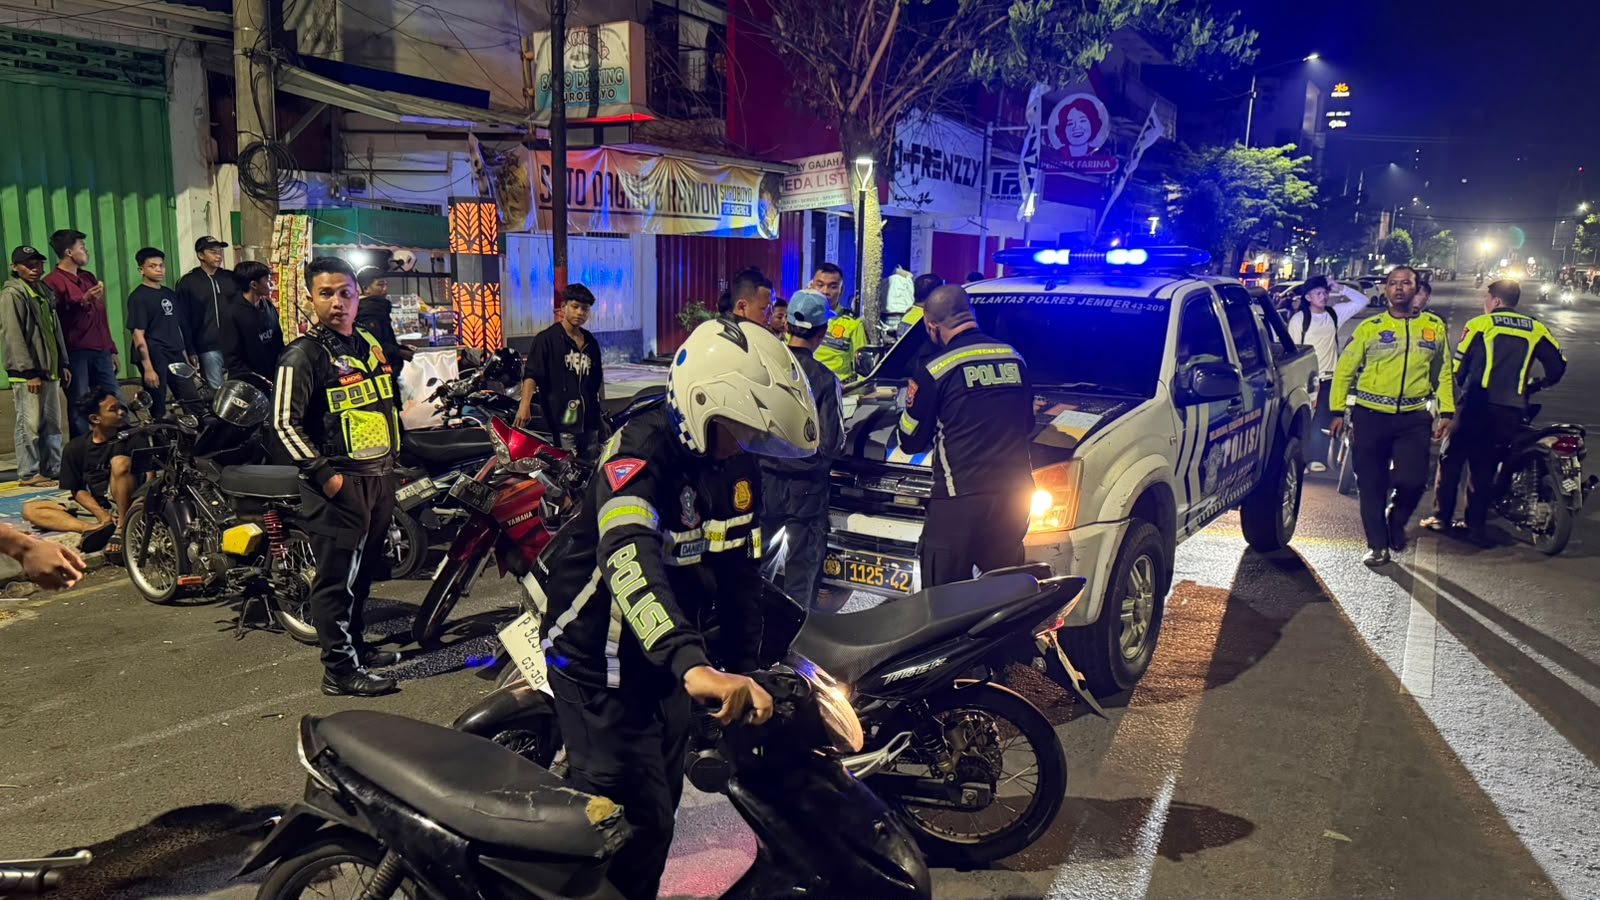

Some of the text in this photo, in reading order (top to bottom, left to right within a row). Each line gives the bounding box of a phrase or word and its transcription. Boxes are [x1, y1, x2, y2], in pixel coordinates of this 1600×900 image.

[808, 157, 839, 171] GAJAH
[1077, 159, 1111, 169] FARINA
[540, 163, 587, 206] STO
[1027, 295, 1075, 305] POLRES
[1077, 297, 1131, 309] JEMBER
[1494, 315, 1532, 328] POLISI
[963, 362, 1022, 388] POLISI
[1222, 423, 1260, 469] POLISI
[506, 510, 533, 527] YAMAHA
[606, 542, 676, 652] POLISI
[517, 616, 532, 628] P
